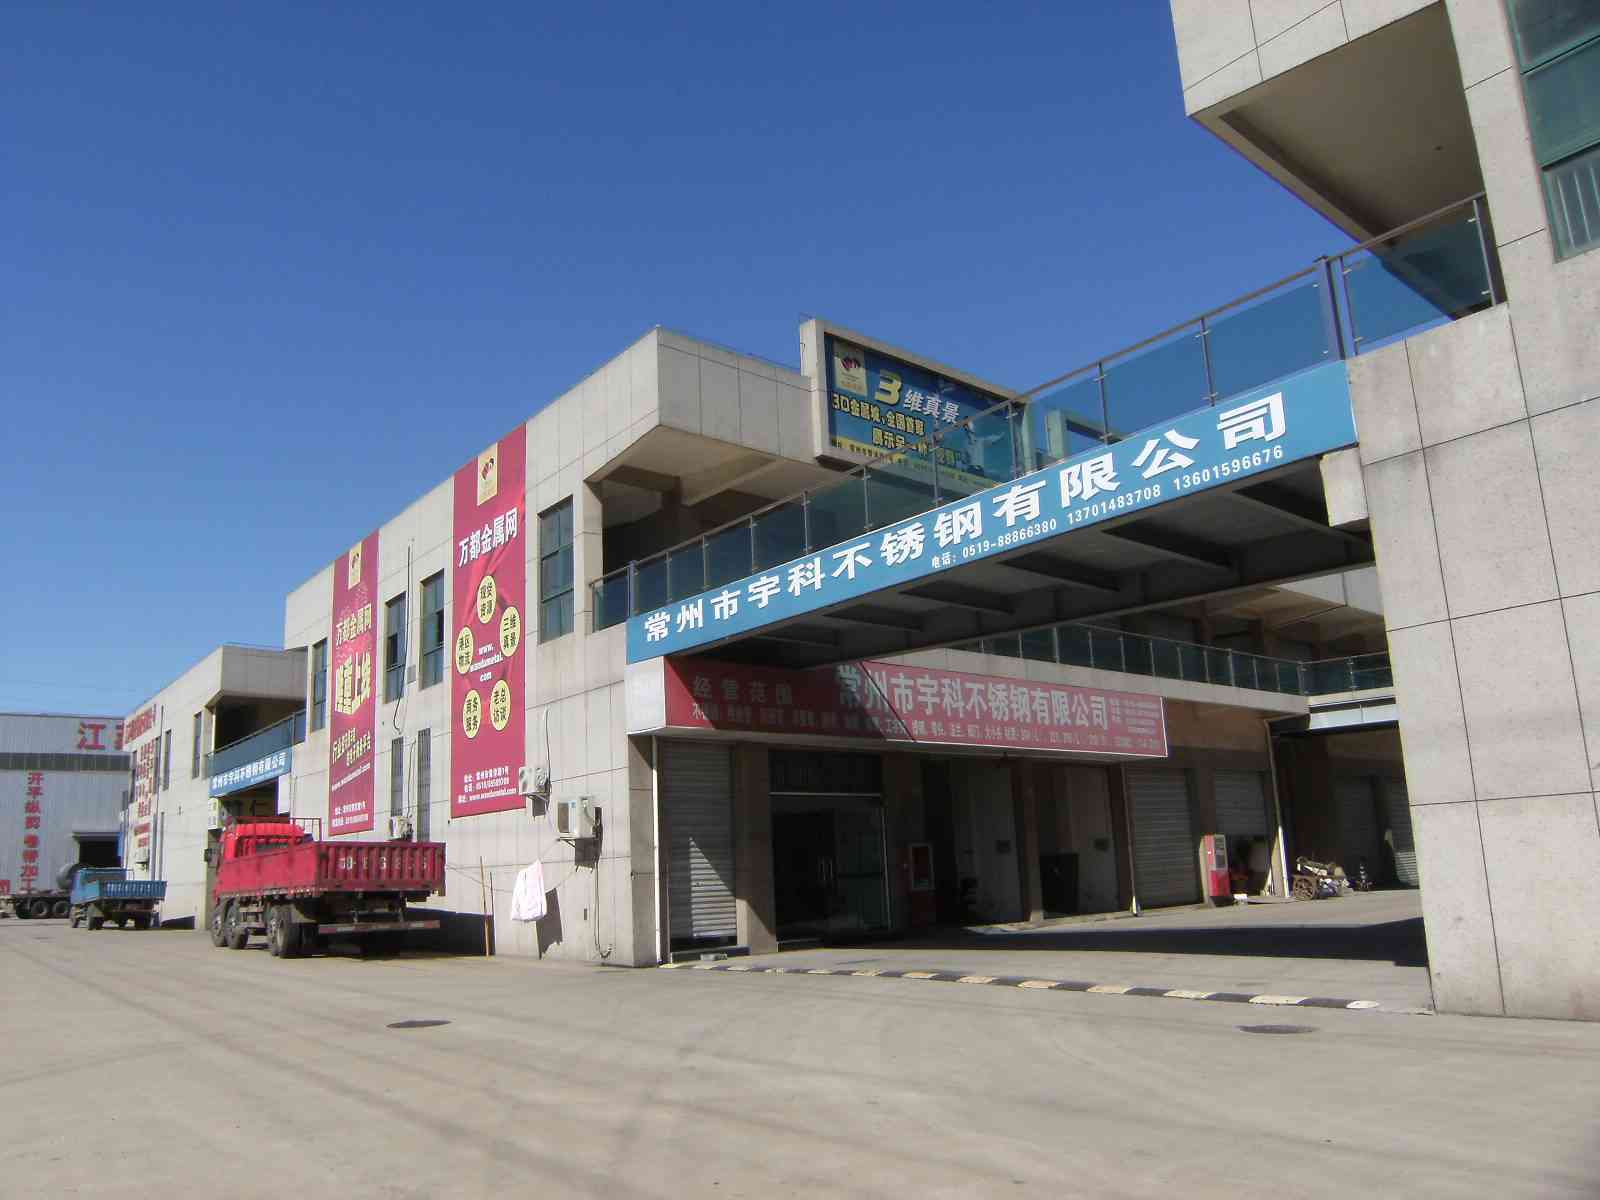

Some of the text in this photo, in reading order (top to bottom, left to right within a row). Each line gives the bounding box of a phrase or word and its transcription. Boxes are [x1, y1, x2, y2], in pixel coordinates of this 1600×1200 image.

[458, 507, 518, 569] 万都金属网
[644, 391, 1287, 643] 常州市宇科不锈钢有限公司
[962, 518, 1058, 560] 0519-88866380
[1066, 484, 1162, 526] 13701483708
[1173, 445, 1284, 492] 13601596676
[837, 663, 1109, 732] 常州市宇科不锈钢有限公司
